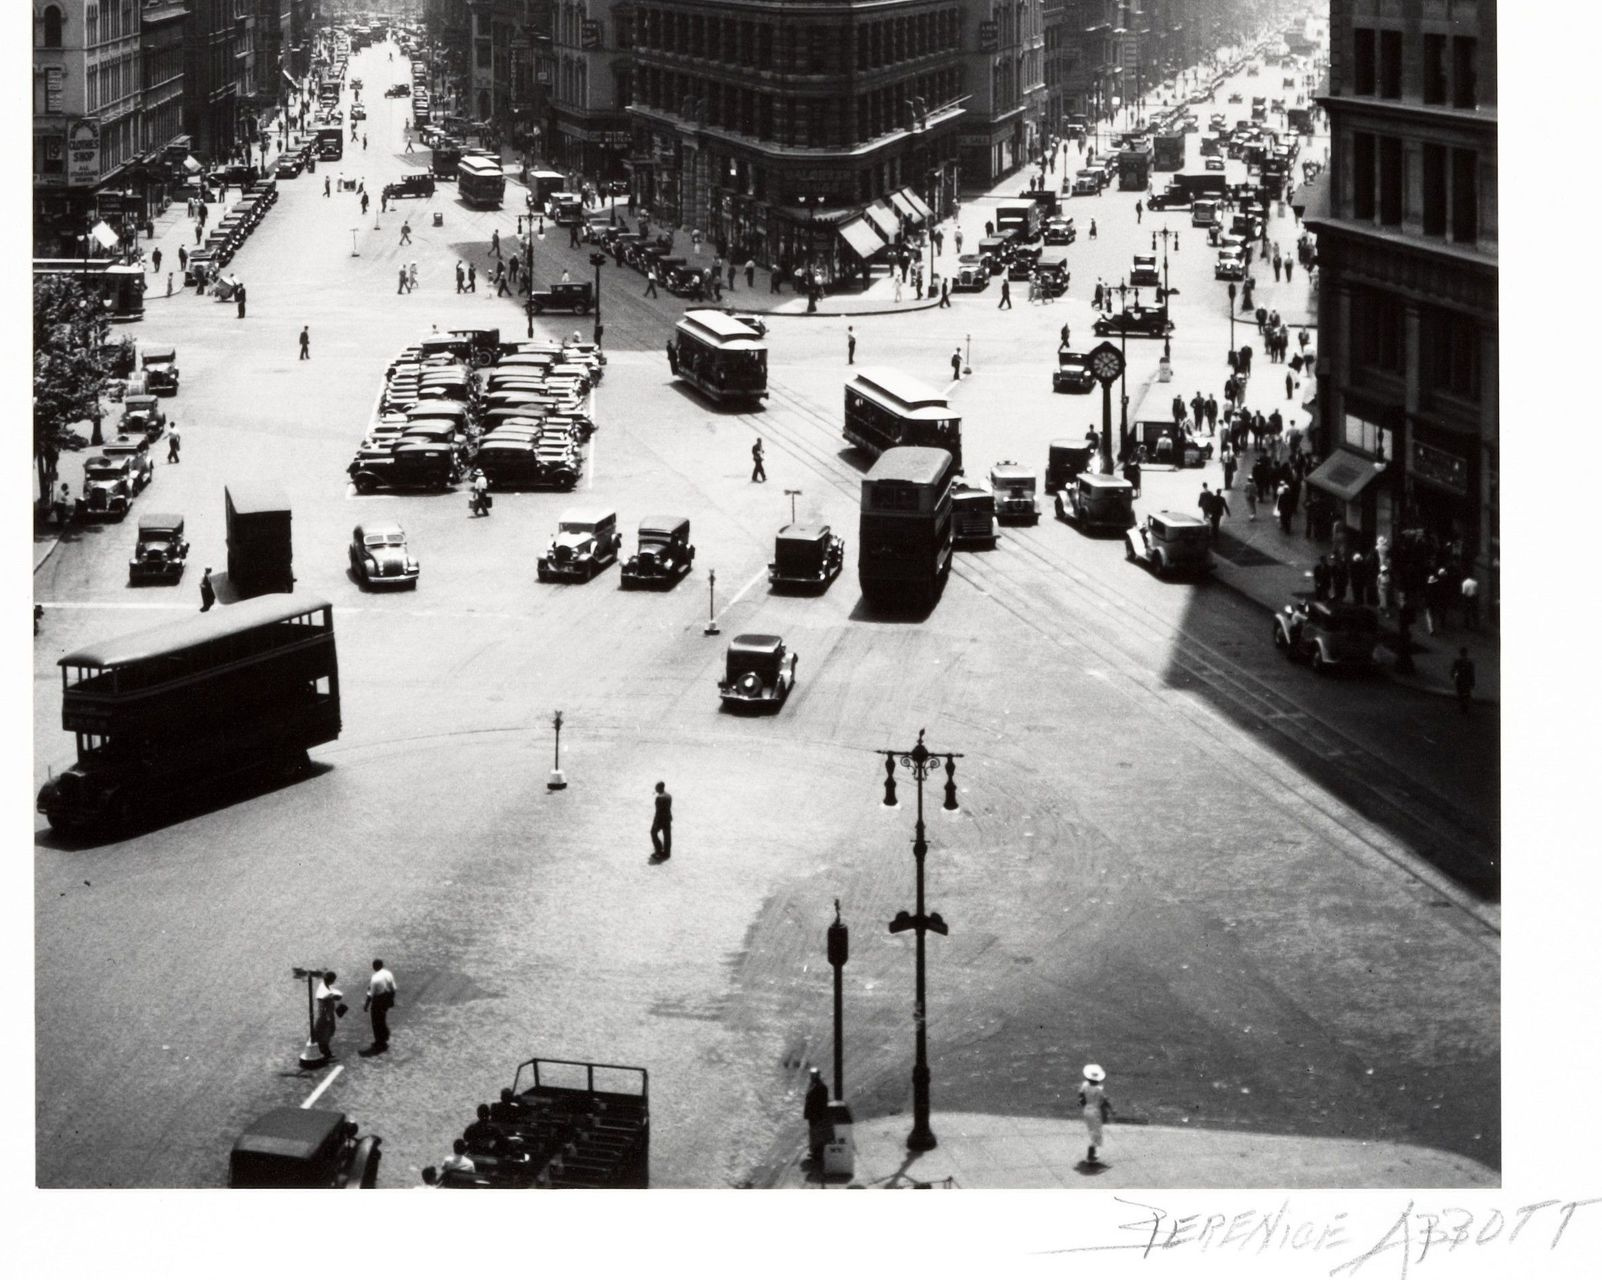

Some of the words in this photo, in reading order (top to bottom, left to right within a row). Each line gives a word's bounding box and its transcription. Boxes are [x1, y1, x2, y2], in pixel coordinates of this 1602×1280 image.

[69, 139, 99, 151] CLOTHES
[73, 151, 95, 162] SHOP
[1028, 1196, 1349, 1260] BERENICE
[1329, 1196, 1602, 1280] ABBOTT
